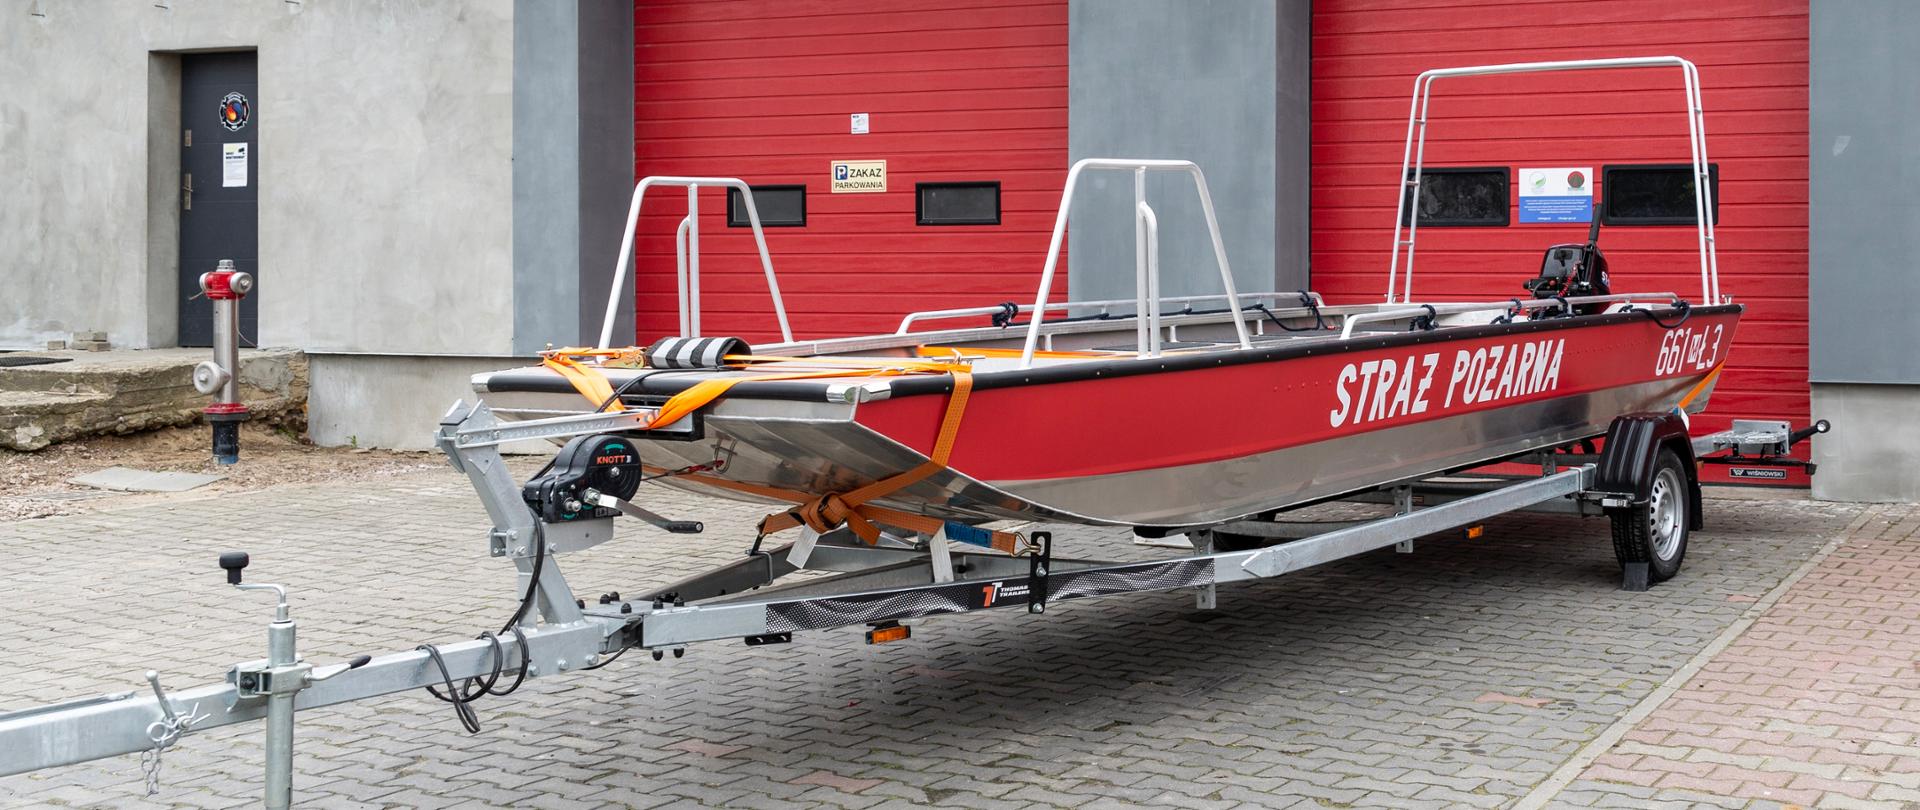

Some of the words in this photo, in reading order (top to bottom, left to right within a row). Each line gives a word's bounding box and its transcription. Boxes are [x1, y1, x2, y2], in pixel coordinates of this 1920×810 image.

[849, 168, 882, 178] ZAKAZ
[835, 181, 883, 189] PARKOWANIA
[597, 455, 625, 465] KNOTT
